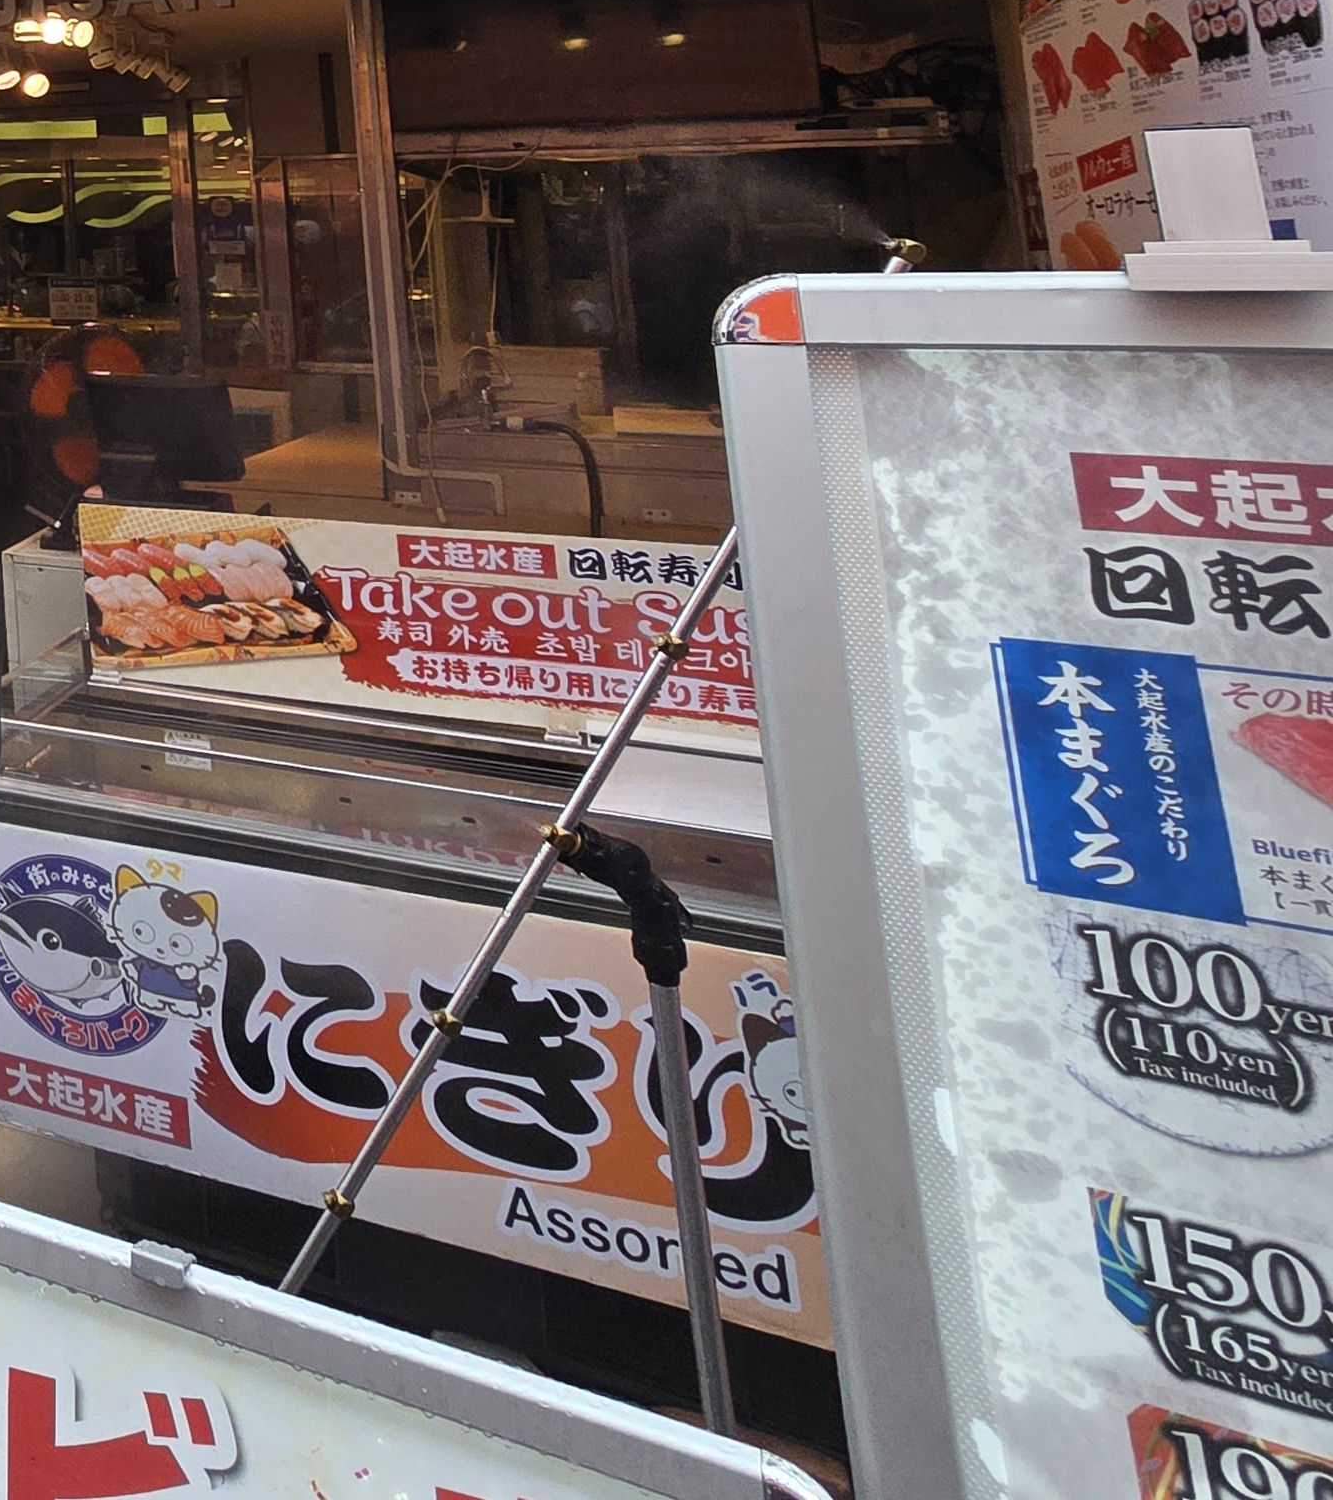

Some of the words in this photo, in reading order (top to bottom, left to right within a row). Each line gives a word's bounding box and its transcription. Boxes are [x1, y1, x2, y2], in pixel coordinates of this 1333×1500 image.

[409, 539, 545, 576] 大起水産
[1083, 546, 1331, 638] 回転
[326, 566, 480, 622] Take
[491, 585, 612, 634] out
[378, 617, 434, 647] 寿司
[535, 632, 601, 664] 초밥
[412, 653, 758, 713] お持ち帰り用にり寿司
[1037, 660, 1136, 886] 本まぐろ
[1133, 668, 1189, 864] 大起水産のこだわり
[11, 982, 149, 1051] まぐろパーク
[5, 1062, 175, 1140] 大起水産
[222, 939, 816, 1222] にぎり
[1133, 1055, 1177, 1081] Tax
[1180, 1066, 1278, 1102] included
[504, 1186, 793, 1304] Assored
[1132, 1215, 1333, 1332] 150
[1189, 1357, 1233, 1385] Tax
